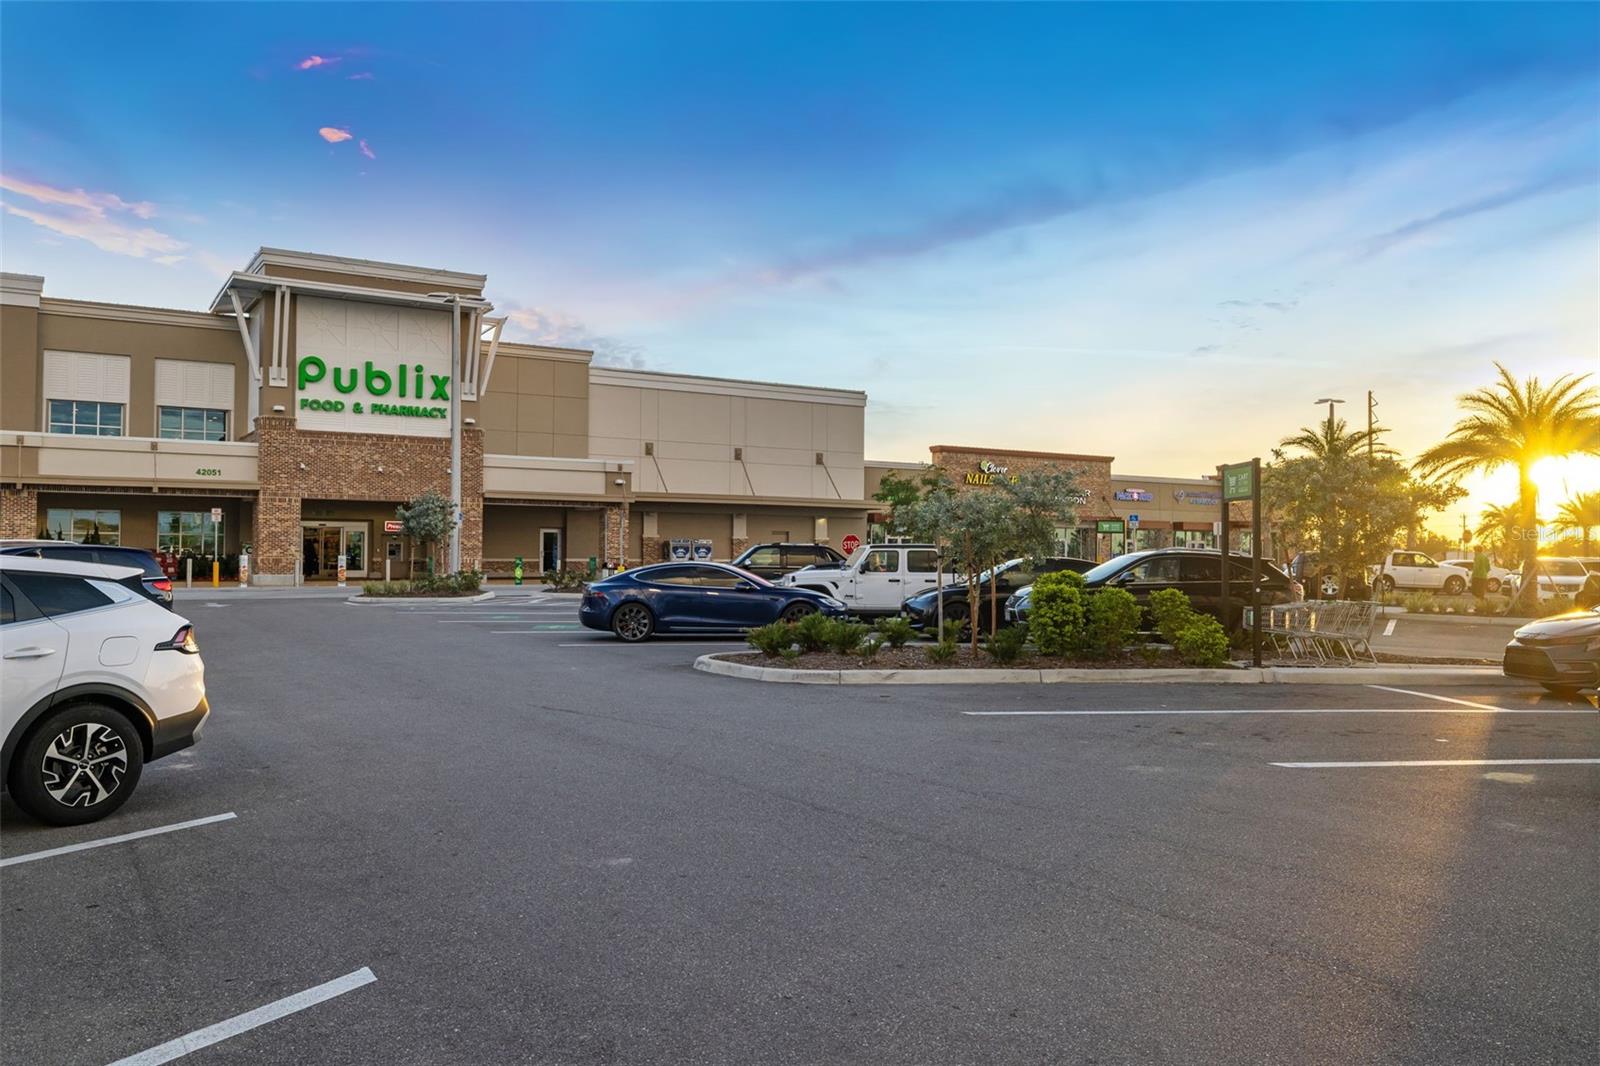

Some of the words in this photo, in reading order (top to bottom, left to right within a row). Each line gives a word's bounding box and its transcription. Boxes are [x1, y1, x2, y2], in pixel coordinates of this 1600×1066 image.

[298, 356, 450, 401] Publix
[300, 399, 345, 412] FOOD
[352, 402, 363, 414] &
[371, 403, 447, 419] PHARMACY
[195, 468, 221, 476] 42051
[965, 473, 994, 485] NAILS
[843, 540, 859, 550] STOP
